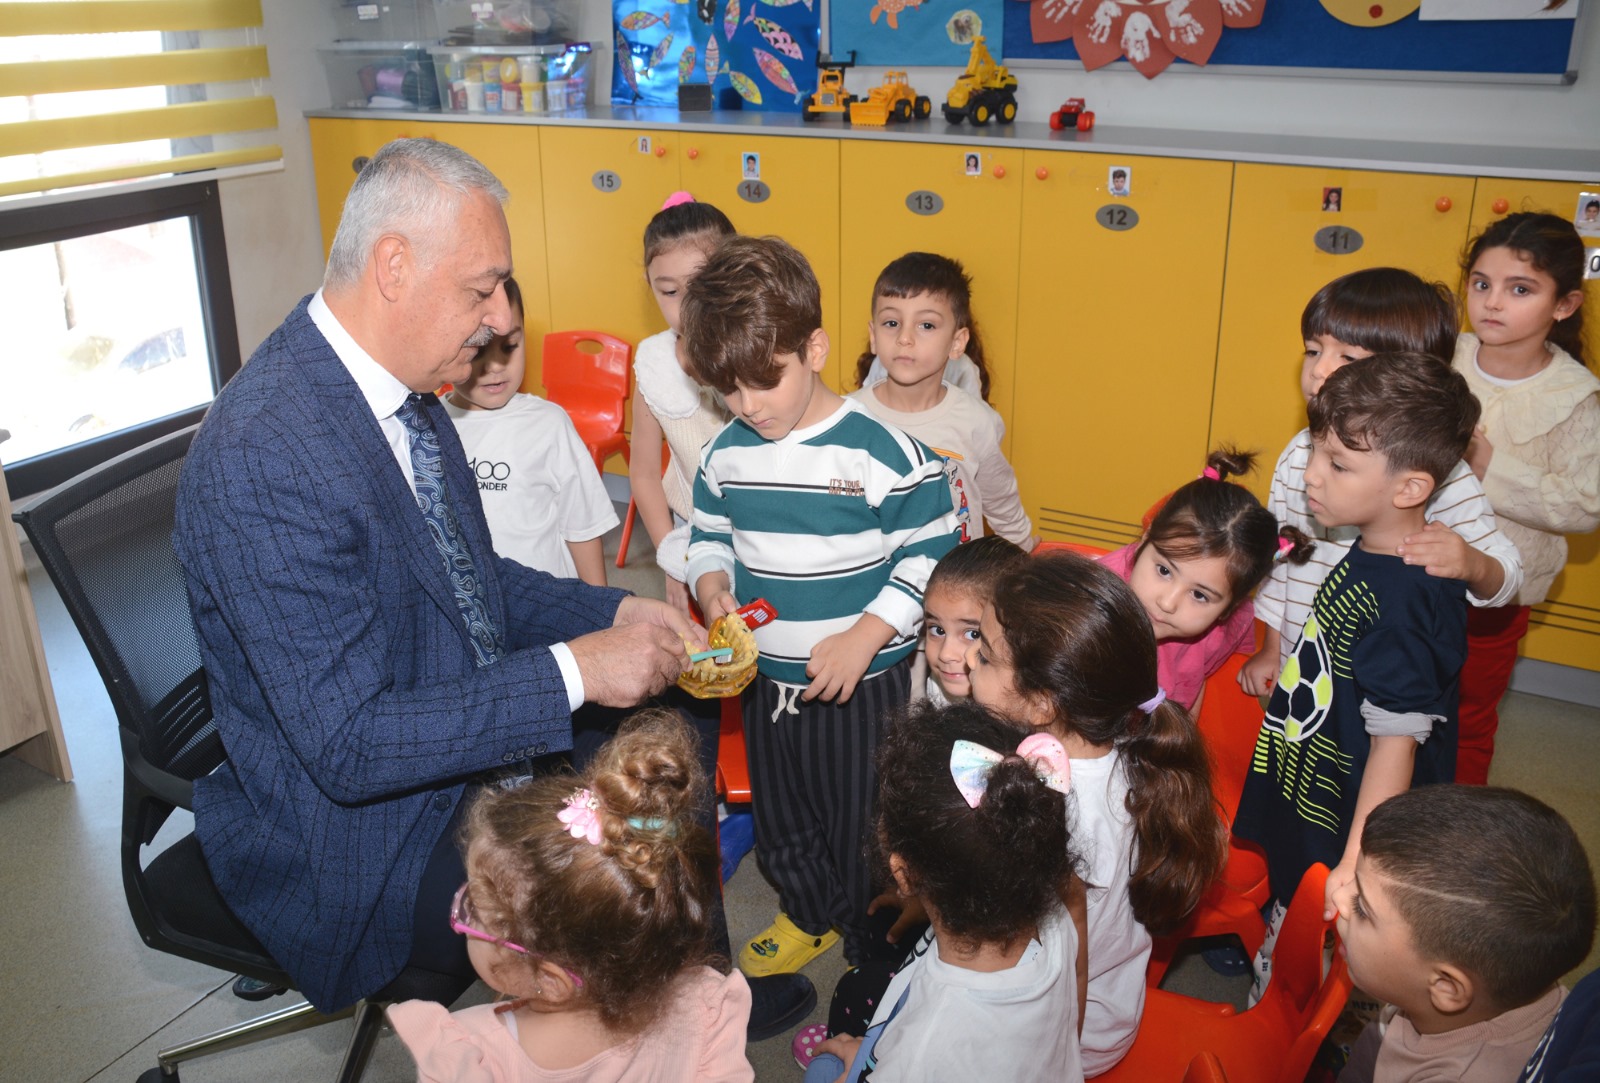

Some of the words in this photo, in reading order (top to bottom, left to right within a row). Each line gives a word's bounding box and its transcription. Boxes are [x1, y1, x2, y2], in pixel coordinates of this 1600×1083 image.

[598, 173, 614, 188] 15
[744, 183, 762, 198] 14
[915, 194, 934, 211] 13
[1106, 208, 1128, 226] 12
[1329, 231, 1350, 250] 11
[468, 457, 511, 481] 100
[476, 481, 508, 491] ONDER
[844, 480, 861, 489] YOUR
